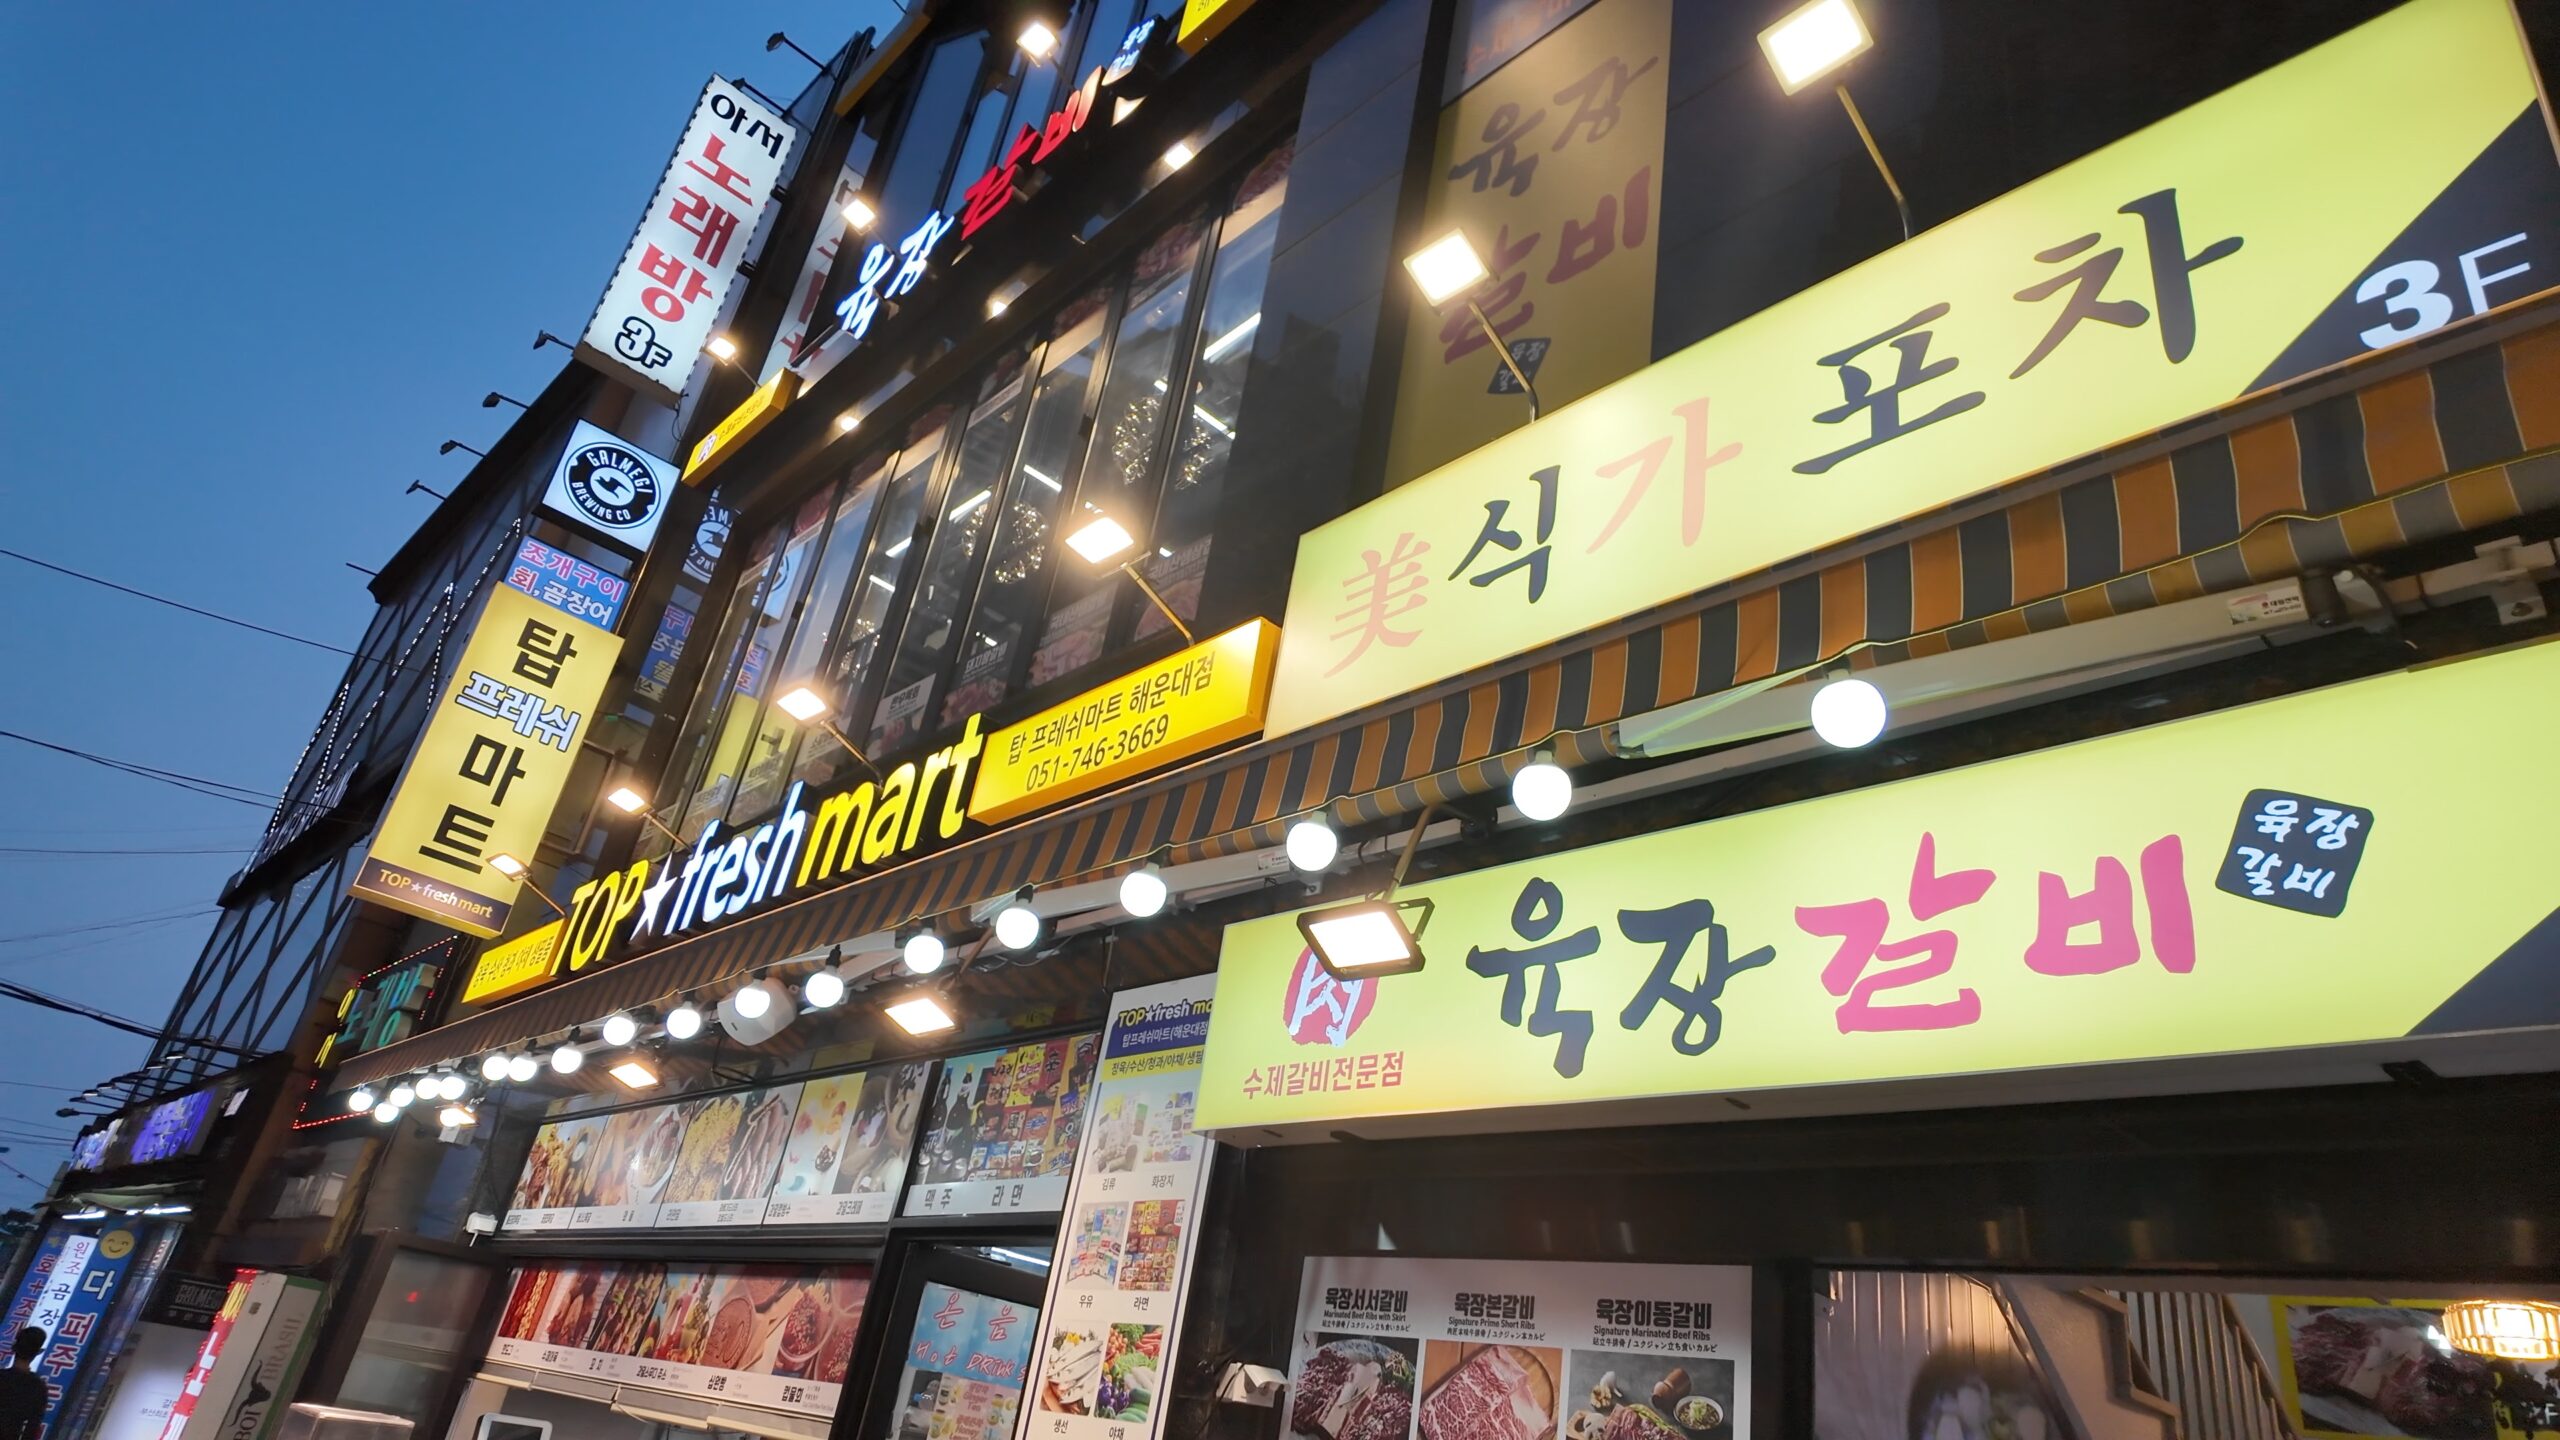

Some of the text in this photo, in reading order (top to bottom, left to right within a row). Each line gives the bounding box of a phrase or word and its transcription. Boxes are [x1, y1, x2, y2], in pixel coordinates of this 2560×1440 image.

[711, 93, 784, 159] 아서
[1448, 56, 1659, 197] 육장
[637, 133, 753, 323] 노래방
[2355, 232, 2532, 349] 3F
[614, 316, 672, 370] 3F
[586, 450, 653, 493] GALMEGI
[572, 481, 631, 521] BREWING CO
[520, 541, 624, 602] 조개구이
[512, 618, 577, 688] 탑
[455, 671, 581, 752] 프레쉬
[1008, 651, 1216, 766] 탑 프레쉬마트 해운대점
[1026, 713, 1170, 792] 051-746-3669
[419, 734, 526, 875] 마트
[2255, 800, 2359, 849] 육장
[556, 711, 987, 973] TOP fresh mart
[380, 869, 493, 918] TOP fresh mart
[2237, 846, 2336, 898] 갈비
[1118, 1008, 1146, 1029] TOP
[1154, 998, 1190, 1022] fresh
[1243, 1051, 1404, 1099] 수제갈비전문점
[924, 1189, 952, 1209] 맥주
[992, 1184, 1023, 1206] 라면
[1152, 1174, 1175, 1188] 화장지
[1079, 1295, 1093, 1308] 우유
[1134, 1297, 1149, 1310] 라면
[1323, 1309, 1351, 1319] Marinated
[1351, 1311, 1365, 1320] Beef
[1365, 1312, 1378, 1320] Ribs
[1378, 1312, 1391, 1321] with
[1325, 1287, 1408, 1313] 육장서서갈비
[1454, 1292, 1535, 1320] 육장본갈비
[1596, 1298, 1712, 1330] 육장이동갈비
[1448, 1316, 1535, 1330] Signature Prime Short Ribs
[1594, 1325, 1711, 1341] Signature Marinated Beef Ribs
[1054, 1419, 1068, 1434] 생선
[1109, 1427, 1125, 1440] 야채
